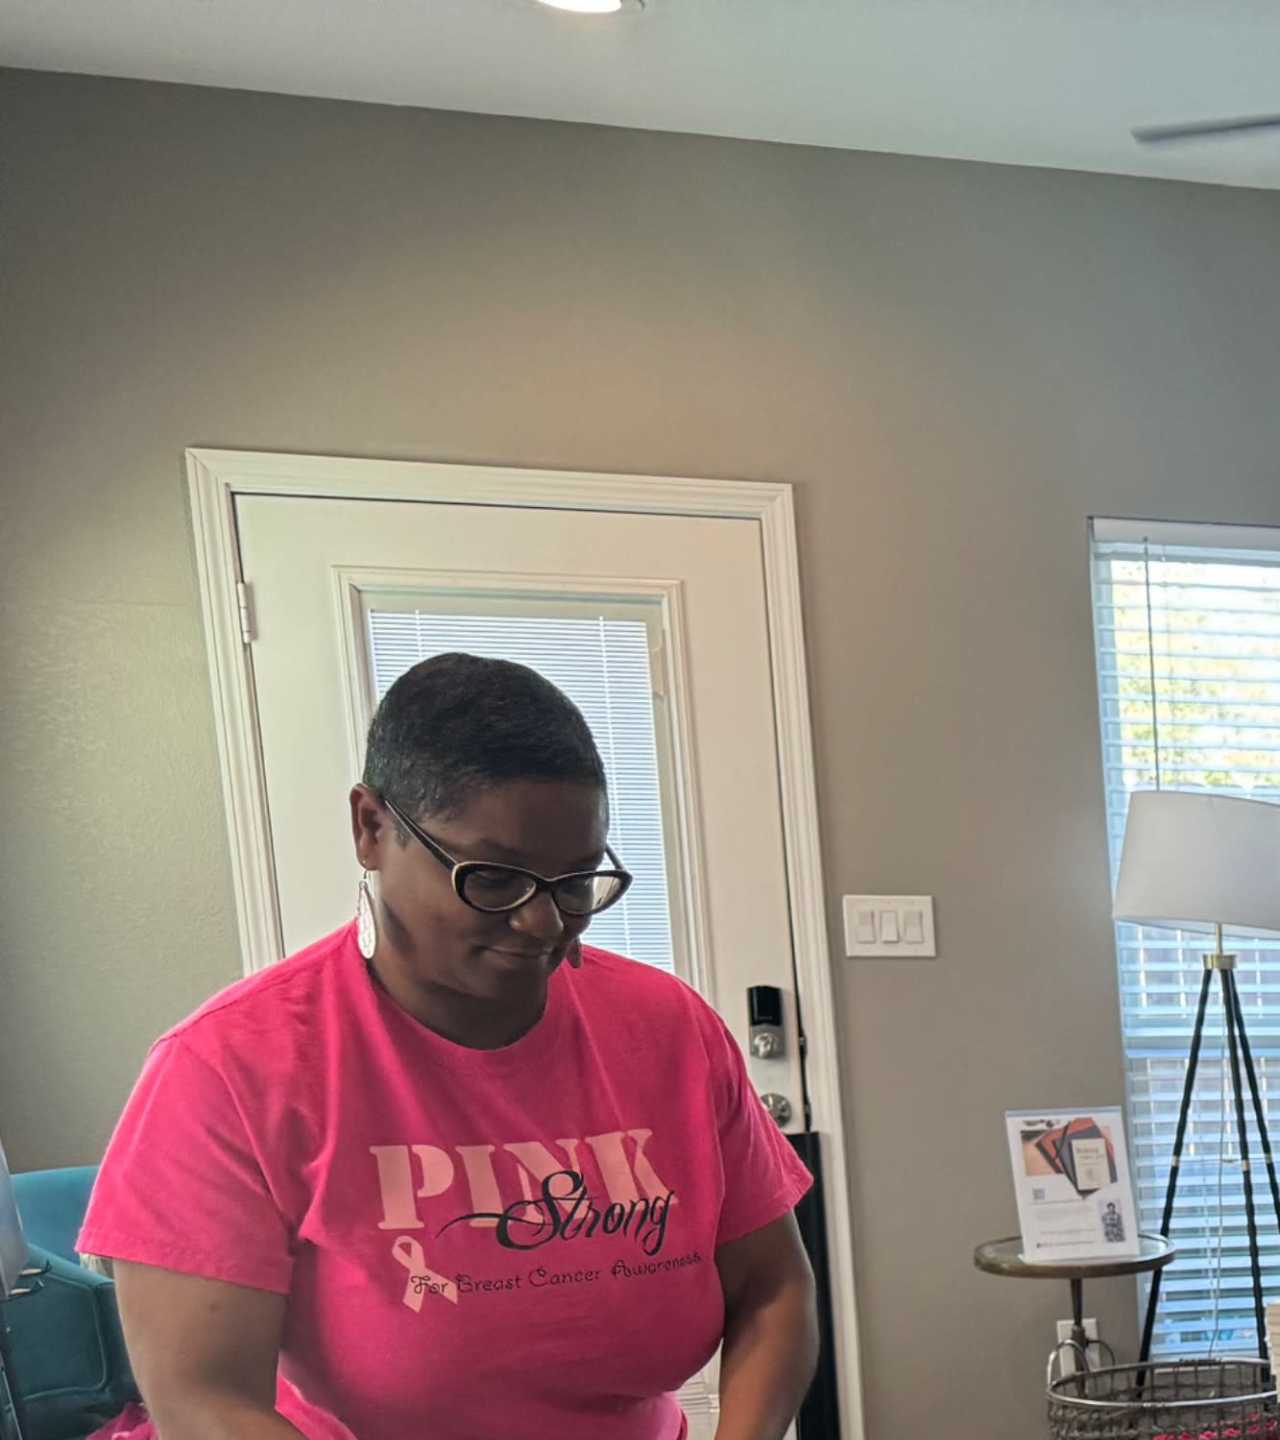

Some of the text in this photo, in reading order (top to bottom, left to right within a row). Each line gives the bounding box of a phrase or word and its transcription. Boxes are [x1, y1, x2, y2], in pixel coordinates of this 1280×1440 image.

[369, 1128, 679, 1230] PINK
[436, 1170, 675, 1256] Strong
[411, 1252, 703, 1295] For Breast Cancer Awareness
